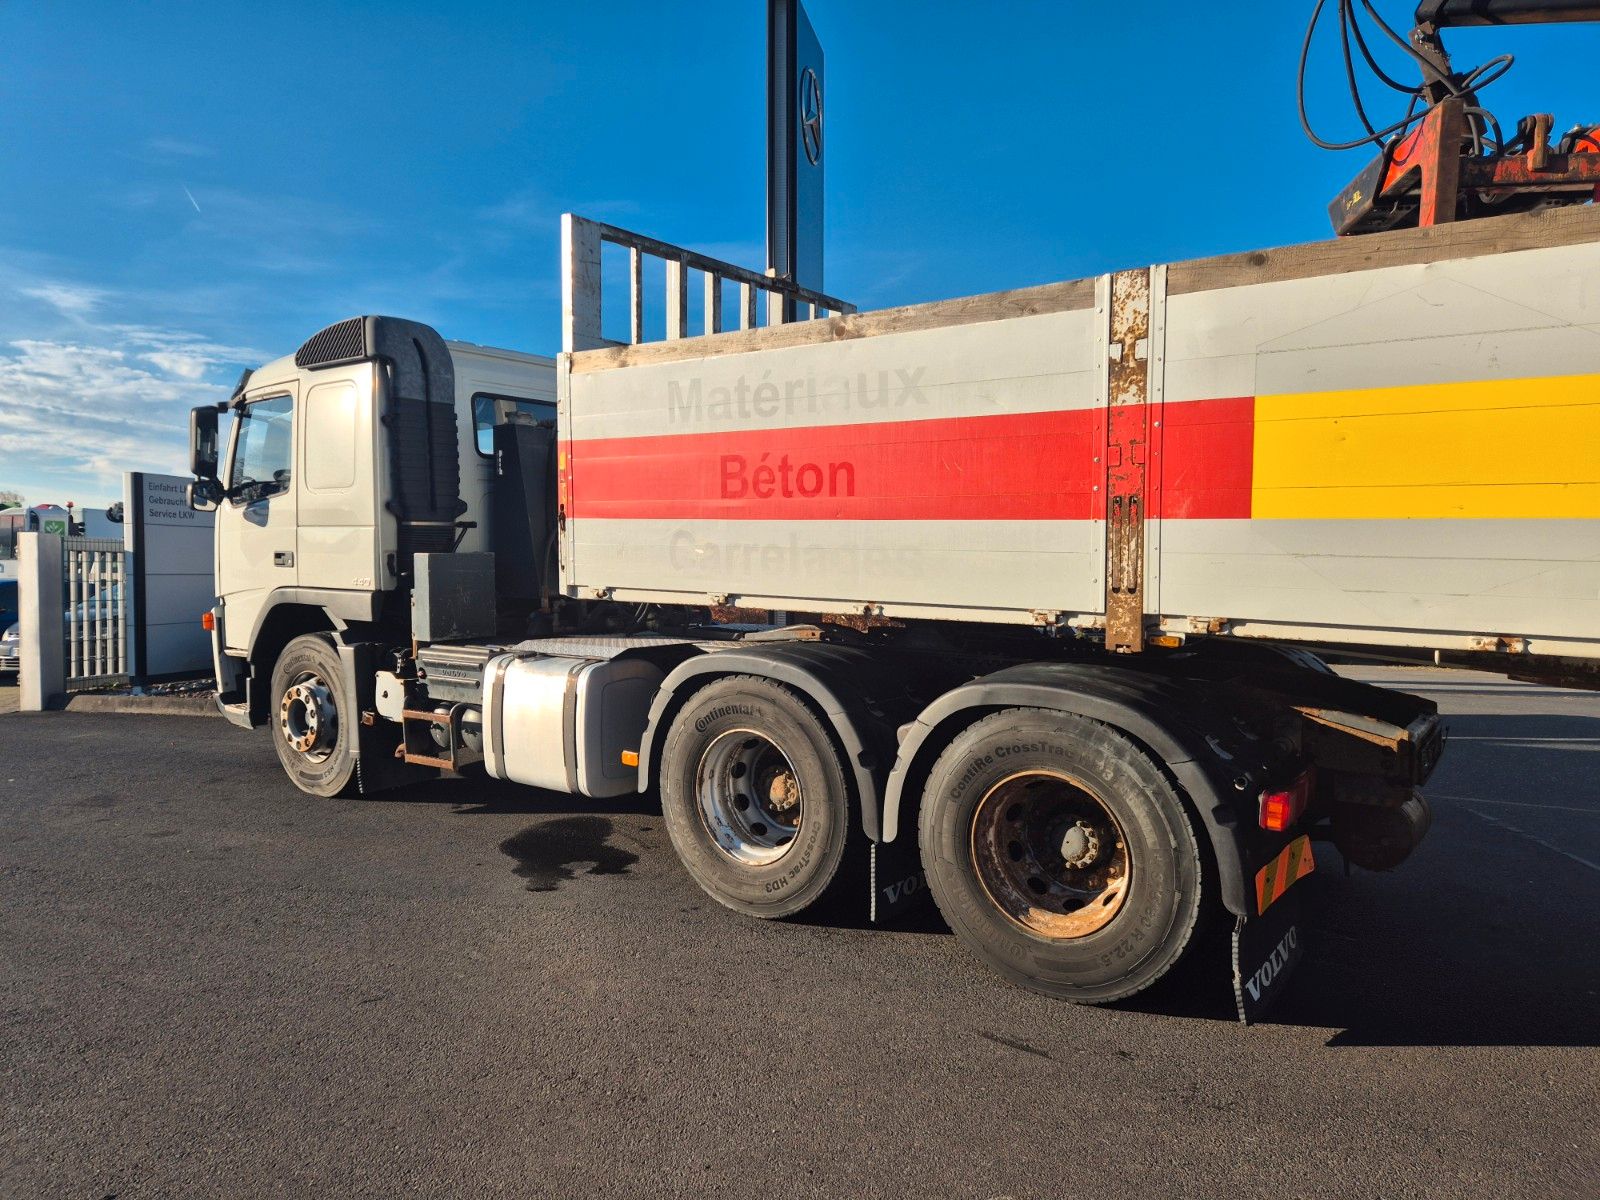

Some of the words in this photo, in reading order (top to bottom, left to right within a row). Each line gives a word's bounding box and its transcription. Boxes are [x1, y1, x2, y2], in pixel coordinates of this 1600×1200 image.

[666, 365, 930, 424] Matériaux
[148, 482, 178, 493] Einfahrt
[719, 452, 856, 499] Béton
[149, 508, 177, 519] Service
[178, 511, 195, 520] LKW
[694, 704, 755, 733] Continental
[950, 754, 994, 800] ContiRe
[994, 740, 1075, 760] CrossTrac
[788, 819, 822, 884] CrossTrac
[764, 874, 790, 894] HD3
[1245, 925, 1297, 1002] VOLVO
